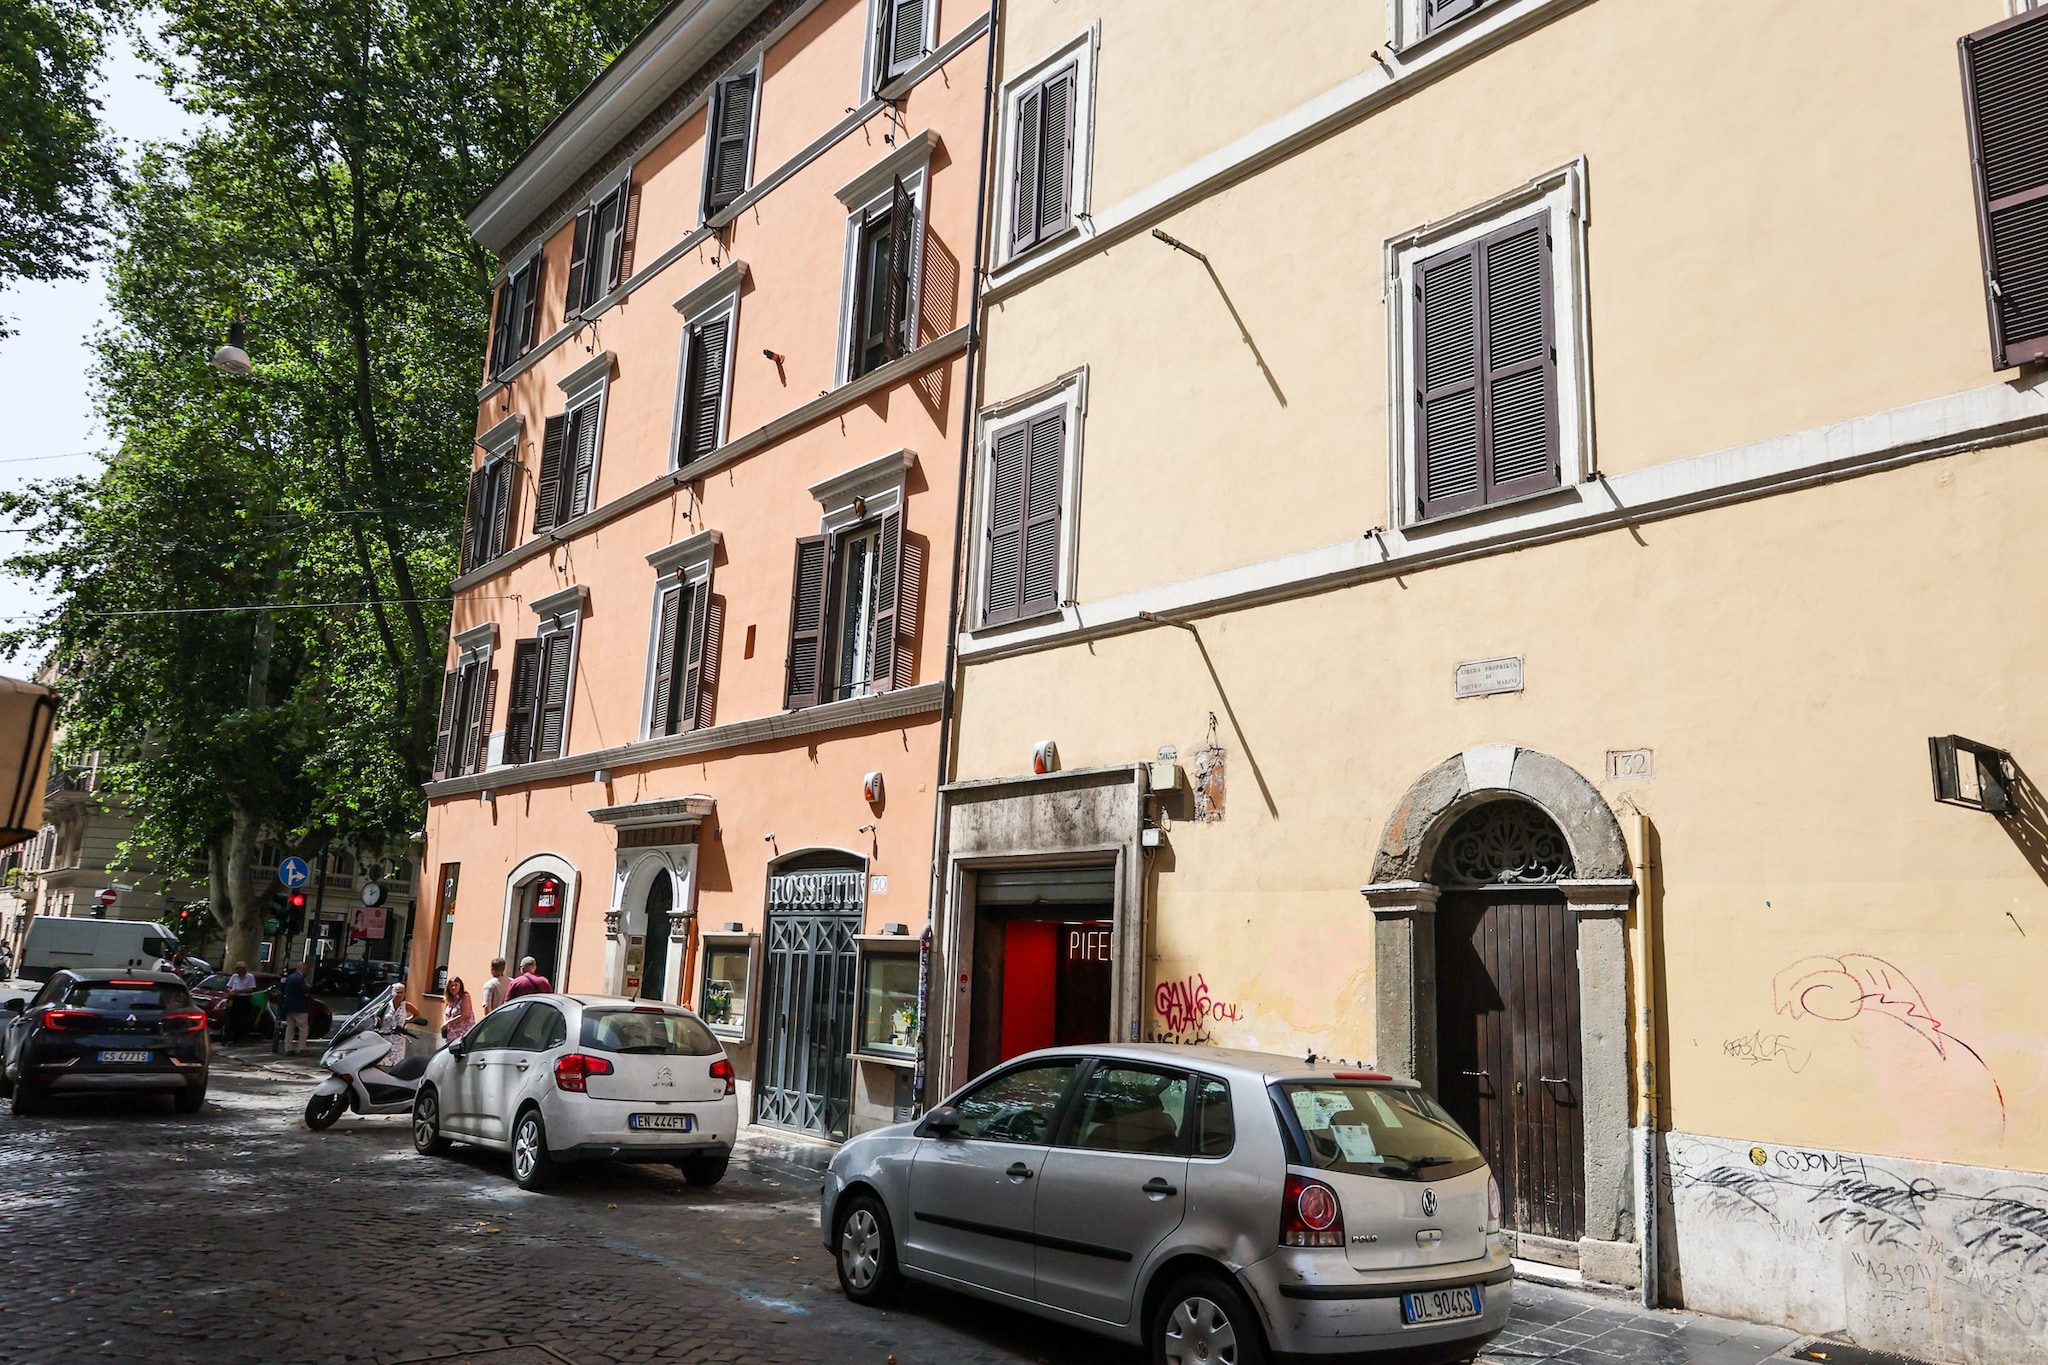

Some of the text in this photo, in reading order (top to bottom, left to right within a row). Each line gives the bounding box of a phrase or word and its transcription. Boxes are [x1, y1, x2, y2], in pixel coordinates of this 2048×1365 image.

[1461, 678, 1518, 691] PIETRO MARINI
[1612, 753, 1648, 777] 132
[871, 877, 887, 891] 130
[1069, 930, 1114, 961] PIFE
[118, 1052, 147, 1061] 477TS
[637, 1115, 684, 1128] EN 444FT
[1351, 1234, 1378, 1244] POLO
[1413, 1289, 1473, 1319] DL 904CS
